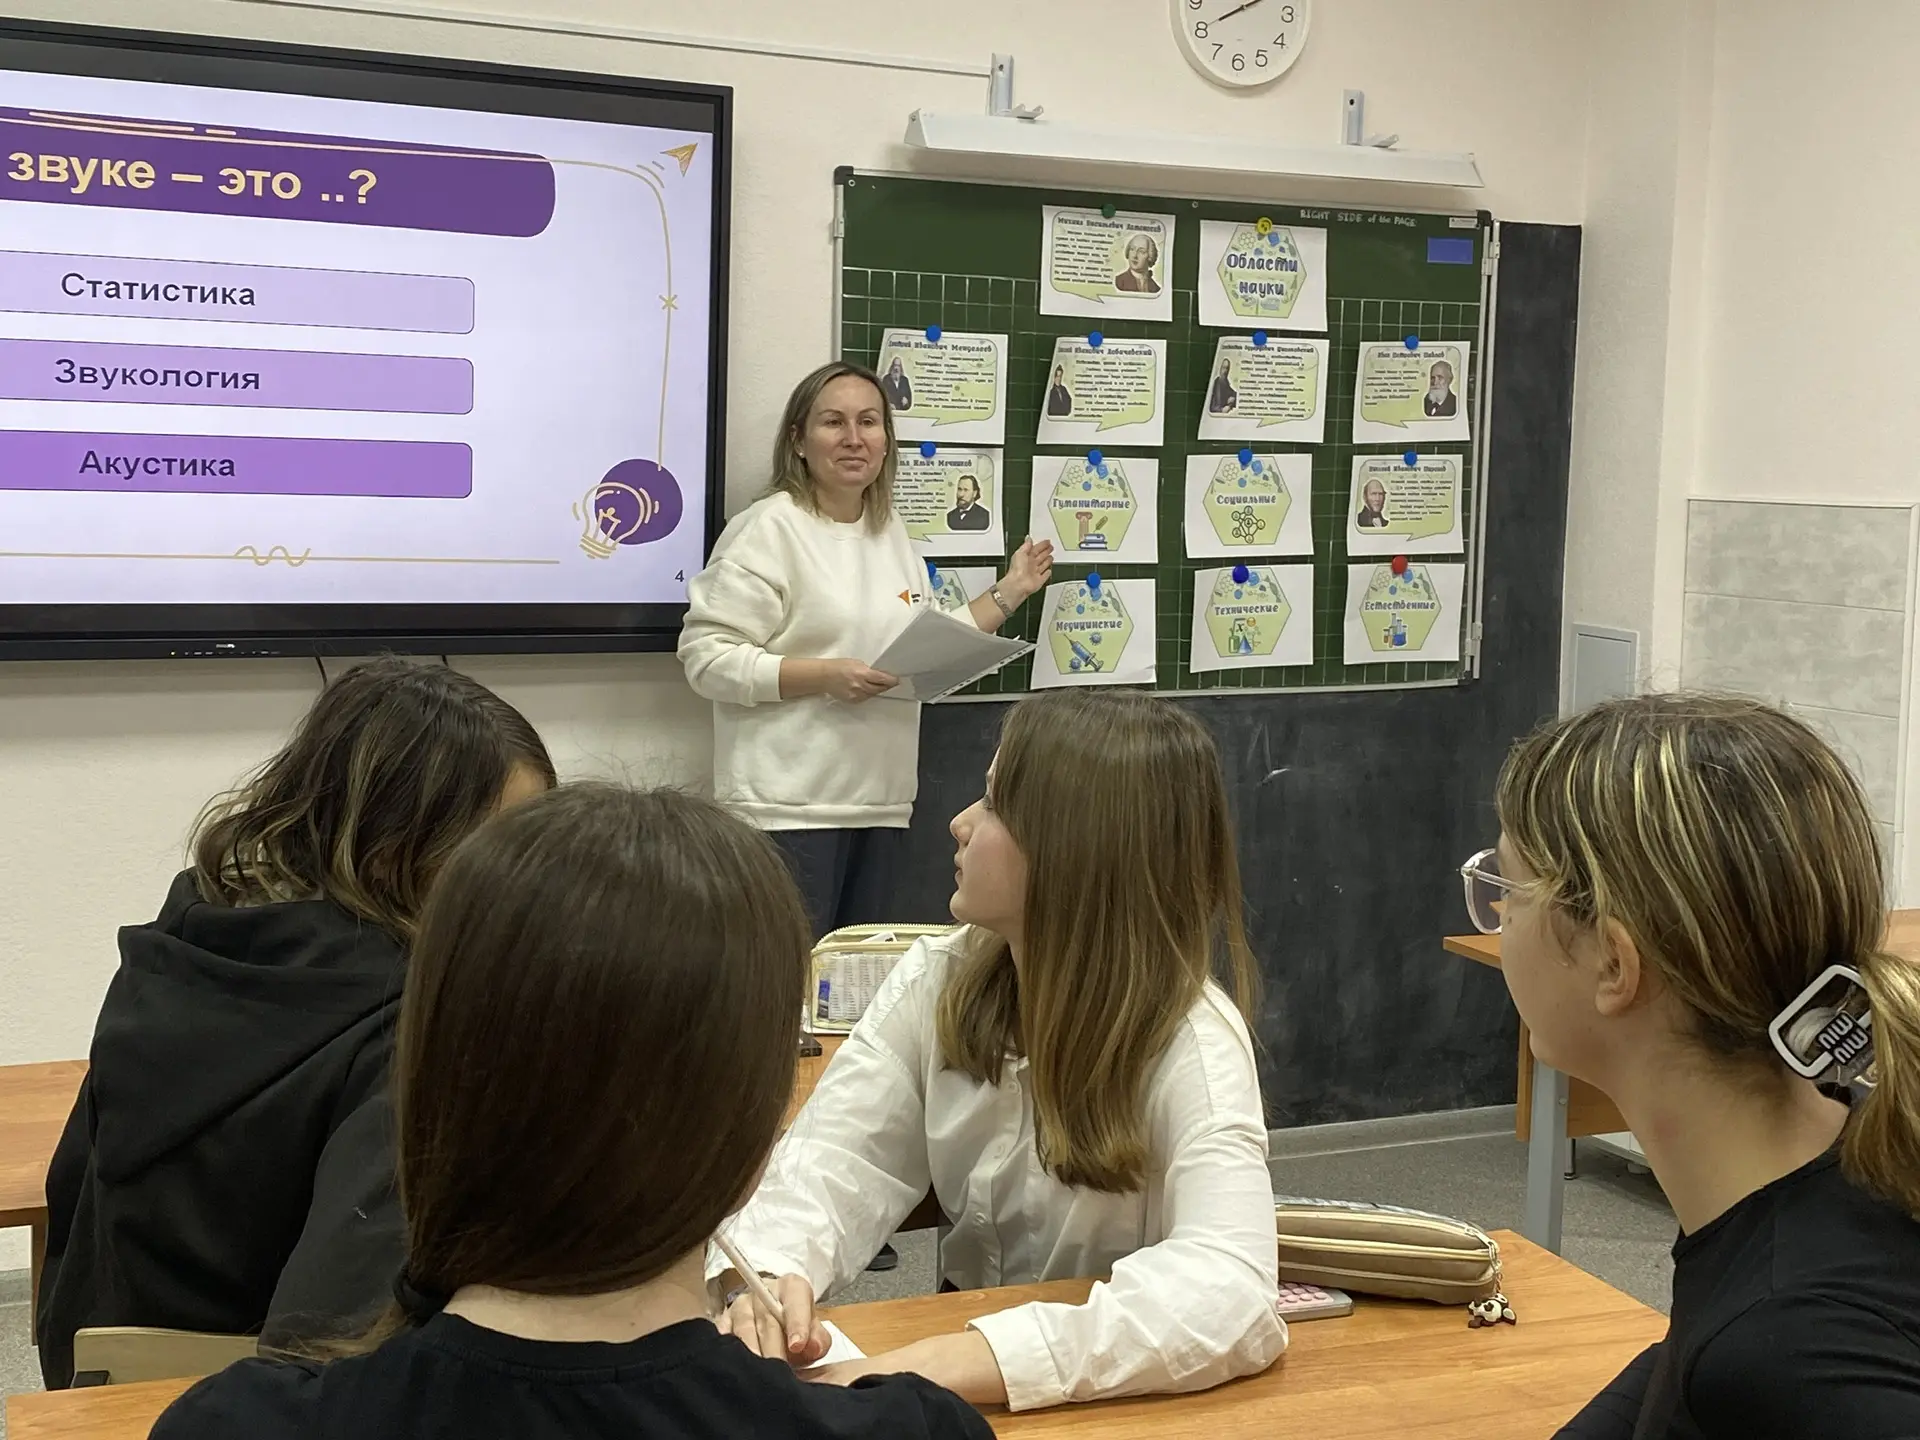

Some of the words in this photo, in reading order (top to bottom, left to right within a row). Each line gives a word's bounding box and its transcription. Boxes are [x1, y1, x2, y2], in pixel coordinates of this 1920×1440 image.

[1281, 5, 1294, 23] 3
[1194, 21, 1208, 38] 8
[1273, 32, 1286, 49] 4
[1211, 43, 1223, 60] 7
[1255, 49, 1268, 67] 5
[1231, 53, 1245, 71] 6
[7, 152, 156, 194] звуке
[217, 167, 302, 200] это
[1300, 209, 1330, 220] RIGHT
[1337, 212, 1363, 223] SIDE
[1394, 216, 1417, 227] PAGE
[1226, 252, 1298, 272] Области
[60, 271, 256, 307] Статистика
[1239, 281, 1284, 298] науки
[54, 356, 260, 390] Звукология
[79, 448, 236, 478] Акустика
[1053, 498, 1131, 510] Гуманитарные
[1216, 494, 1276, 505] Социальные
[675, 569, 685, 582] 4
[1214, 603, 1279, 616] Технические
[1364, 600, 1435, 611] Естественные
[1056, 619, 1122, 632] Медицинские
